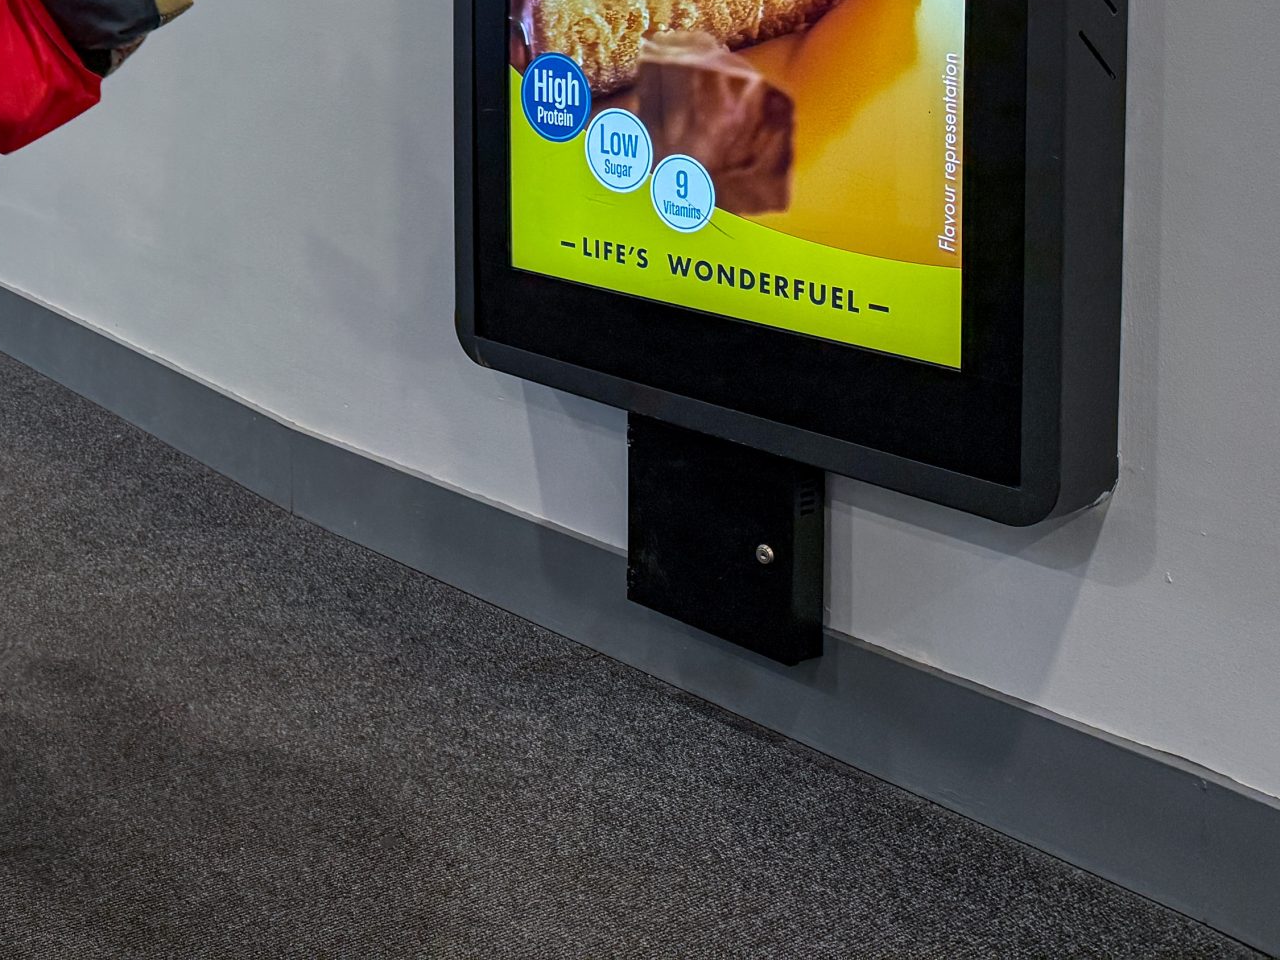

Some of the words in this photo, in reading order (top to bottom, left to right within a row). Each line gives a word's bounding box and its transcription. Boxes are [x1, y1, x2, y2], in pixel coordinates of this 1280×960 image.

[533, 68, 580, 110] High
[537, 106, 574, 127] Protein
[941, 52, 961, 181] representation
[600, 123, 639, 159] Low
[604, 159, 633, 178] Sugar
[675, 170, 689, 200] 9
[663, 200, 701, 220] Vitamins
[937, 189, 956, 252] Flavour
[667, 253, 860, 314] WONDERFUEL
